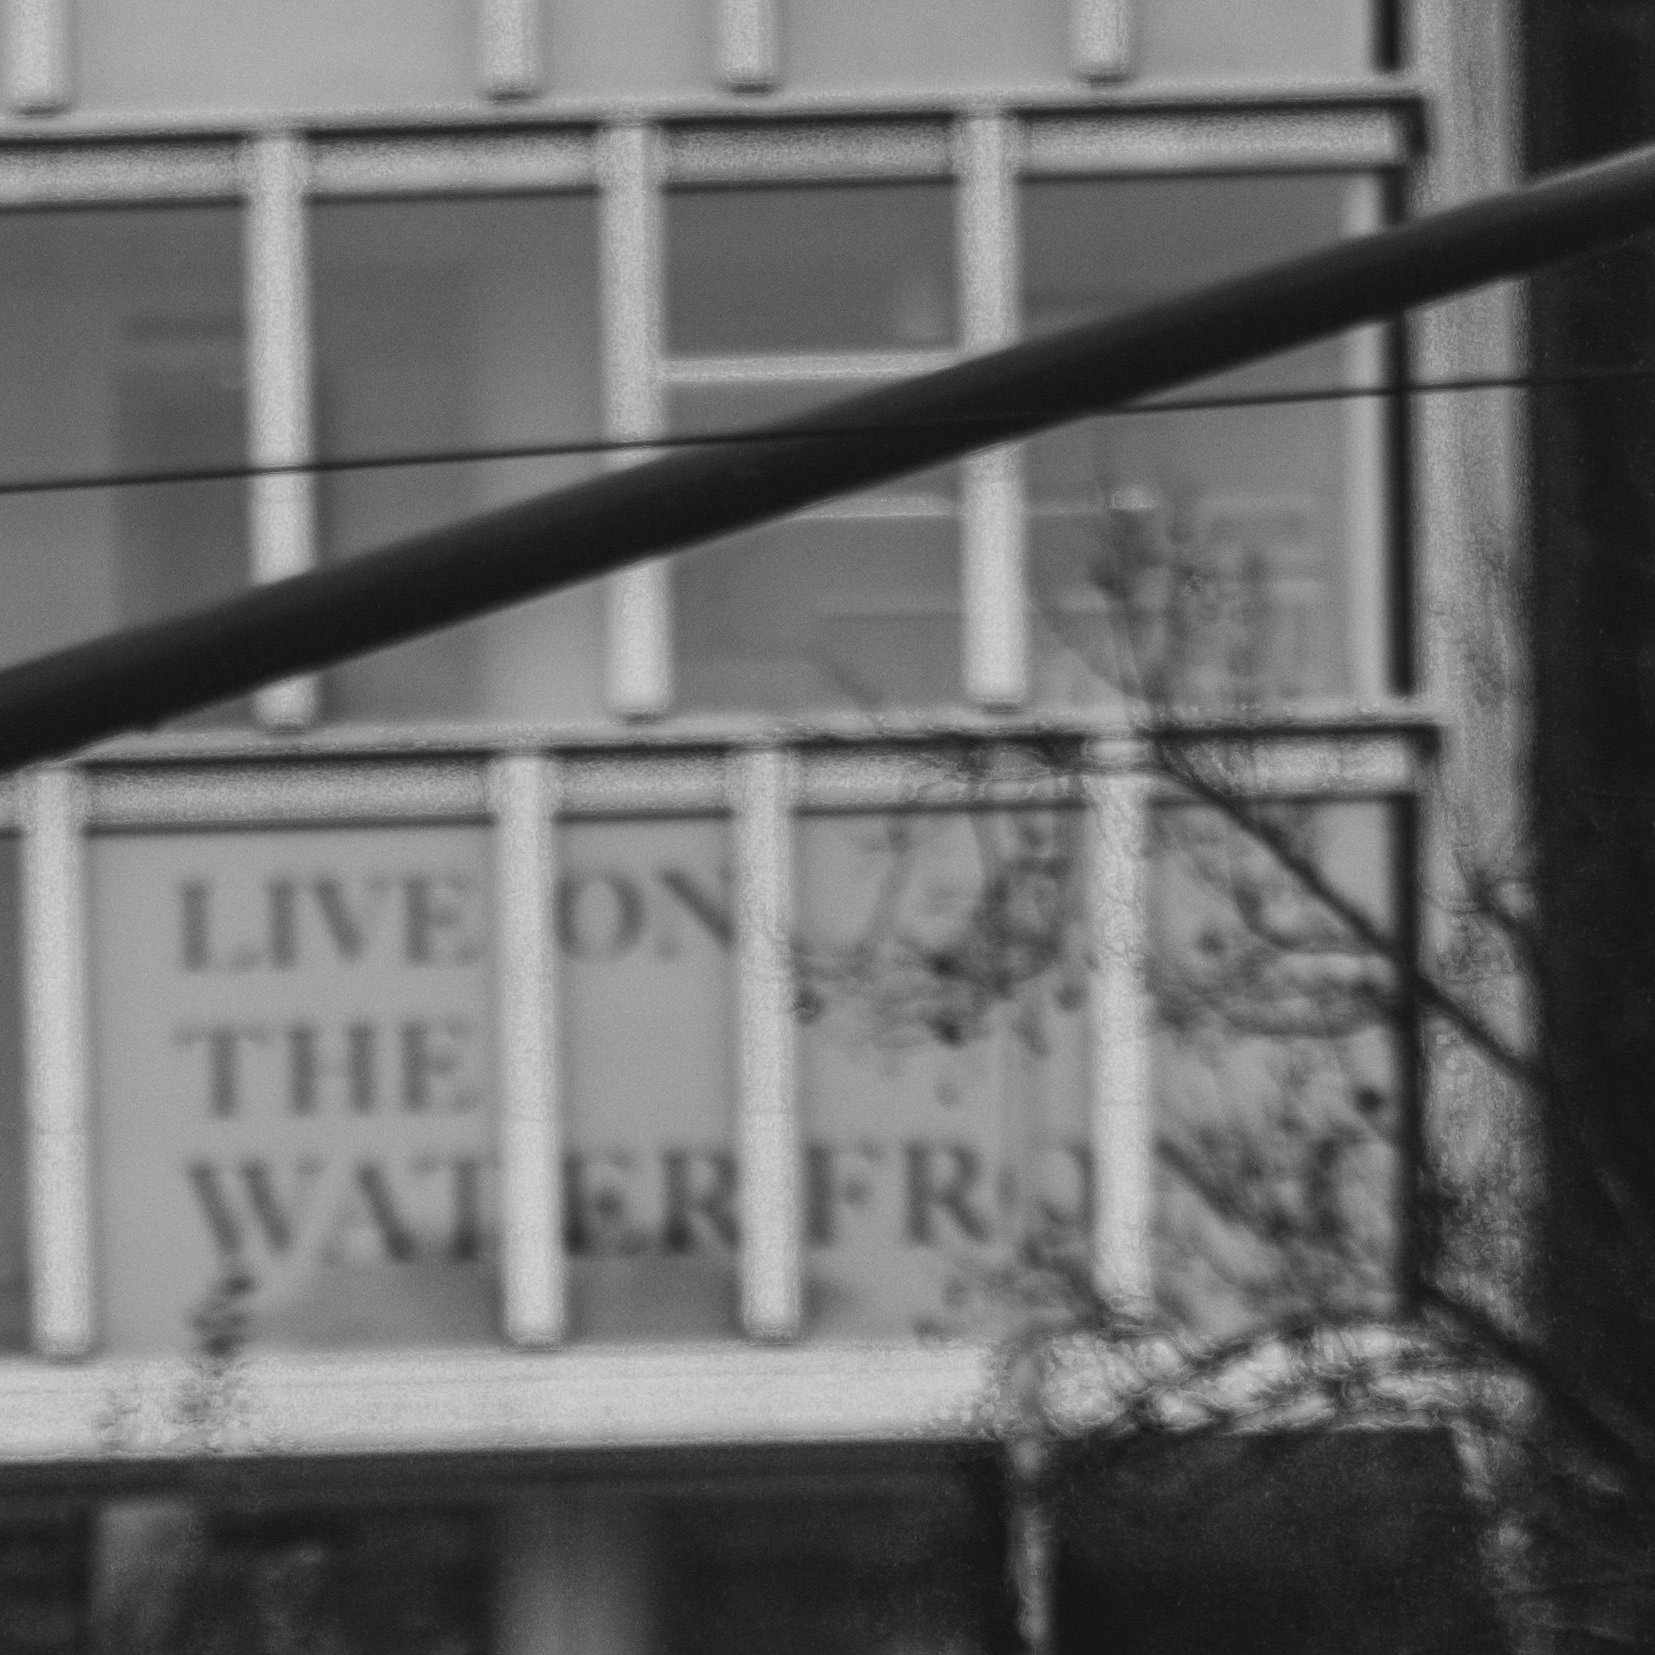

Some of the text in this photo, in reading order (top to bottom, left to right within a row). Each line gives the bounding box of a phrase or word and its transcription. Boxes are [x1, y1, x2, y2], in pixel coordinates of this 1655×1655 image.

[177, 864, 739, 972] LIVE ON
[170, 1013, 481, 1119] THE
